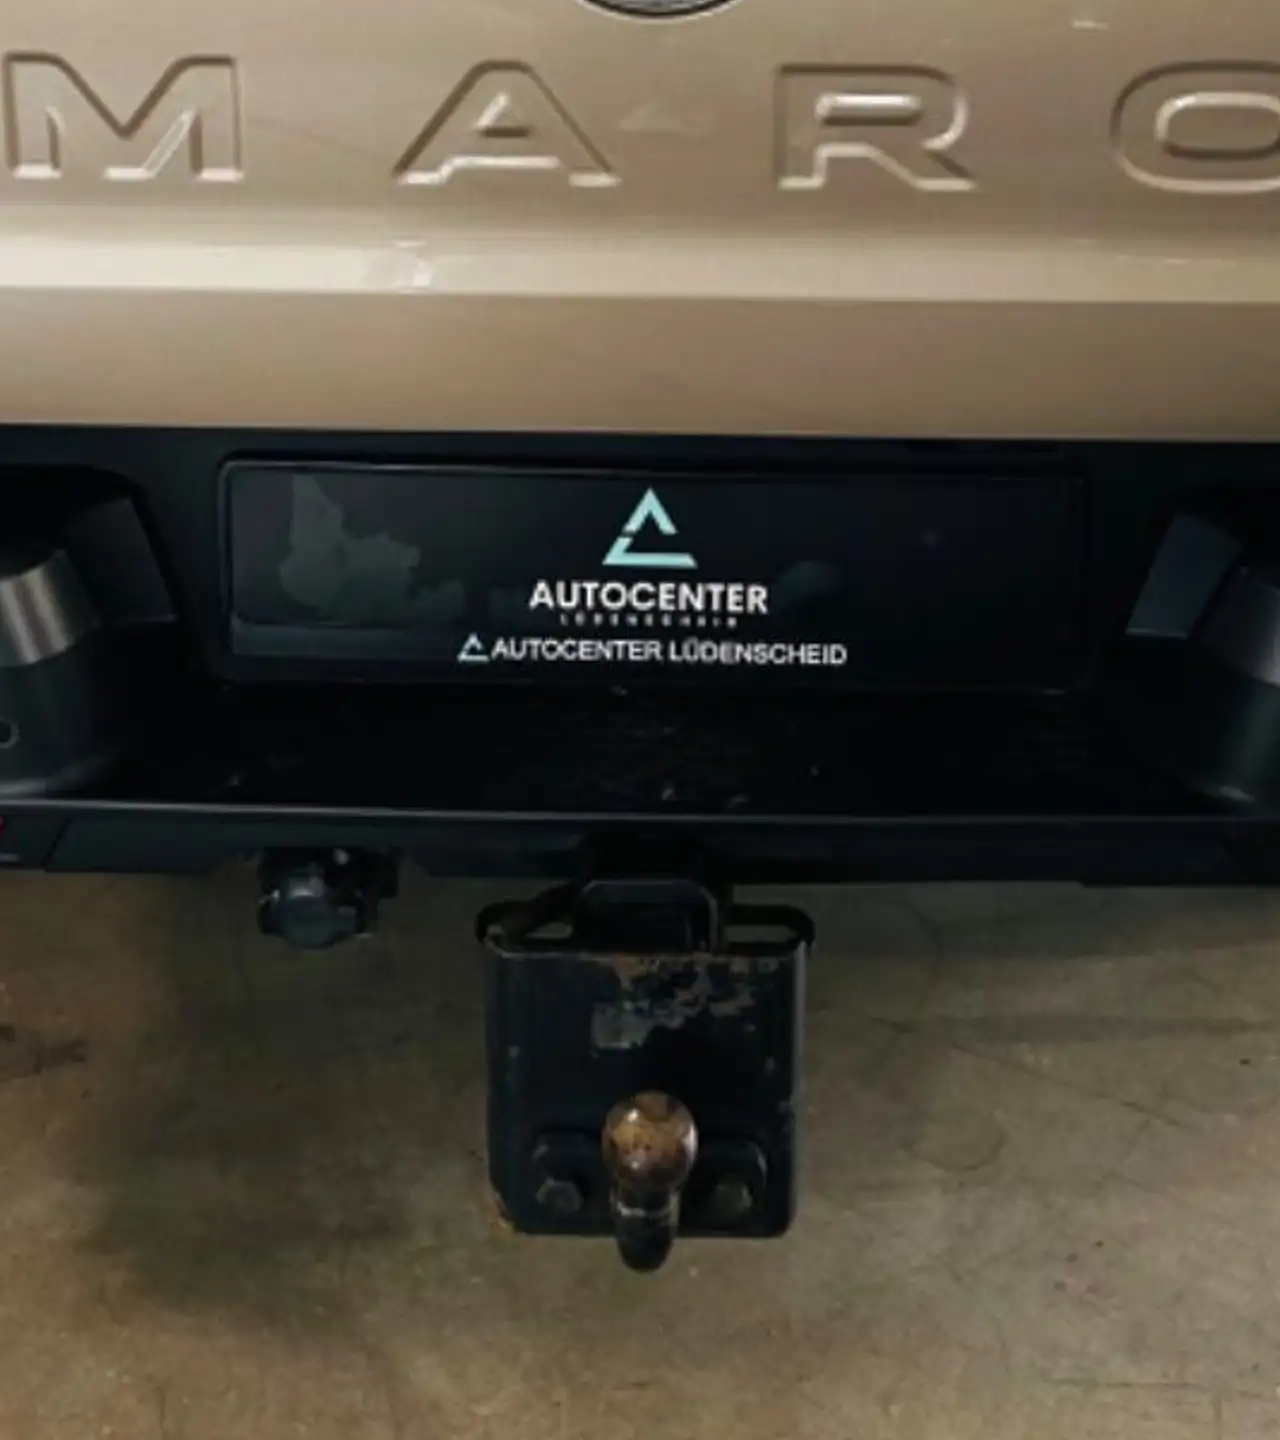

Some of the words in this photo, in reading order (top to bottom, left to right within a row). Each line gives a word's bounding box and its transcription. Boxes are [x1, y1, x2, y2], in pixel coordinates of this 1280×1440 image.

[528, 580, 768, 614] AUTOCENTER
[490, 637, 663, 661] AUTOCENTER
[668, 636, 848, 665] LÜDENSCHEID
